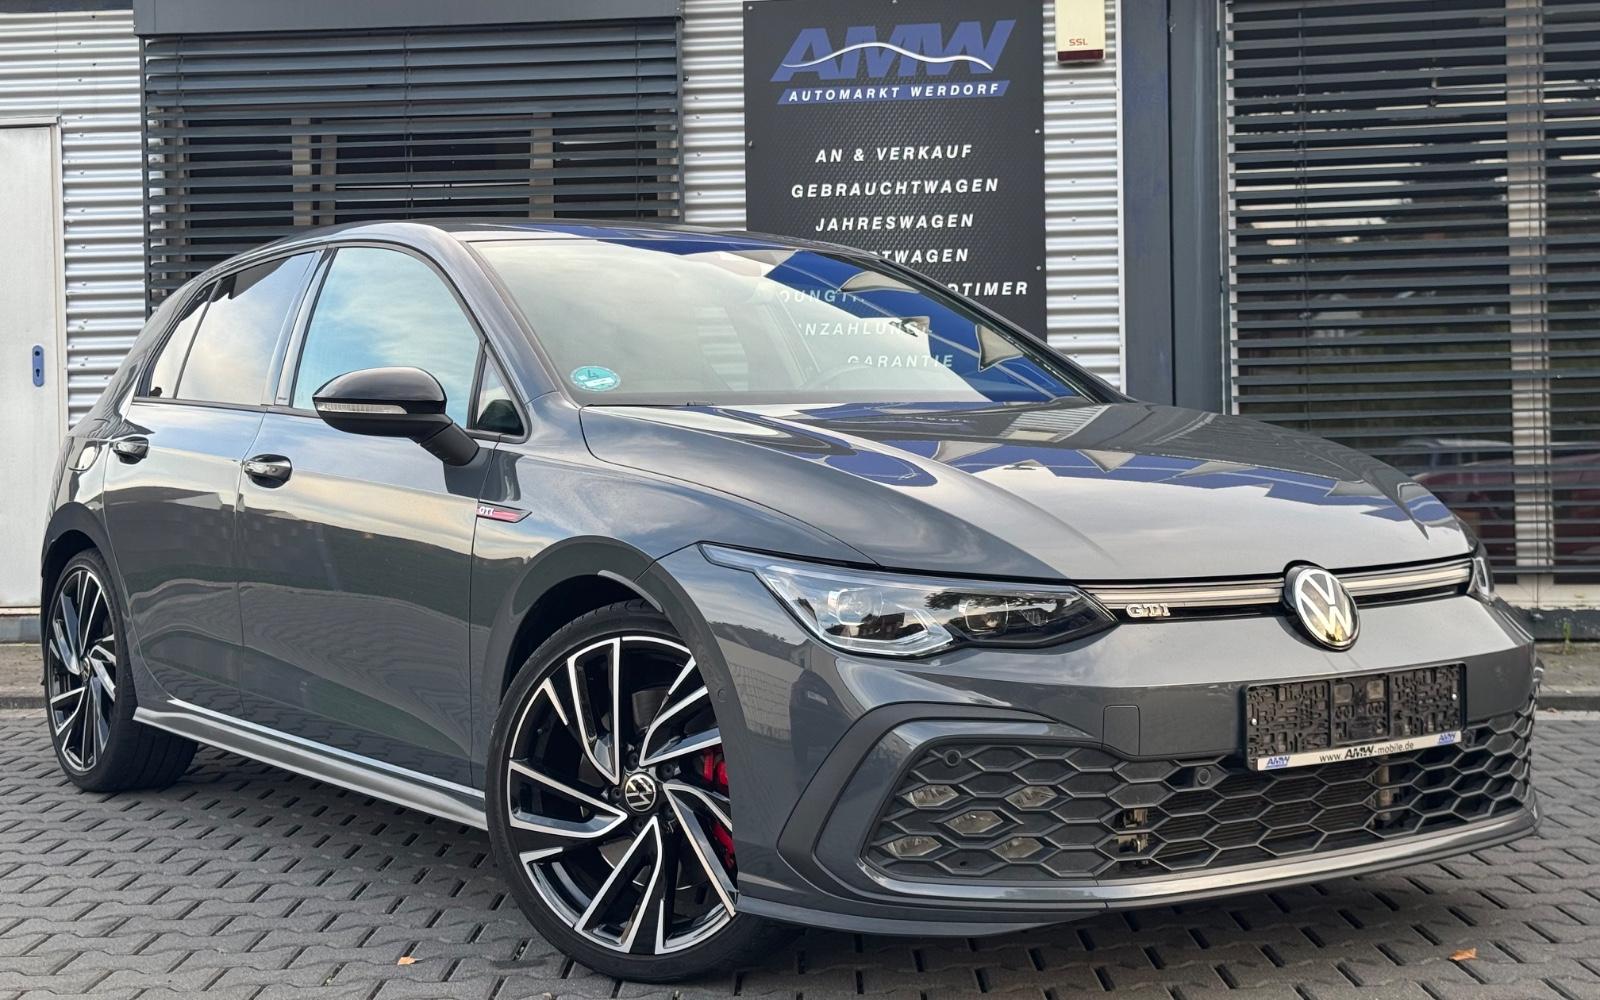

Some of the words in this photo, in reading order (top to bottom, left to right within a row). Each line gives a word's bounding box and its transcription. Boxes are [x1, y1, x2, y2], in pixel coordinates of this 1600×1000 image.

[770, 19, 1016, 82] AMW
[1068, 38, 1089, 47] SSL
[789, 87, 900, 102] AUTOMARKT
[910, 83, 1000, 97] WERDORF
[815, 149, 843, 163] AN
[853, 148, 865, 162] &
[876, 144, 973, 161] VERKAUF
[791, 178, 1000, 198] GEBRAUCHTWAGEN
[815, 213, 974, 232] JAHRESWAGEN
[869, 248, 968, 263] TWAGEN
[947, 281, 1028, 296] DTIMER
[478, 505, 494, 516] GTI
[1126, 602, 1170, 618] GTI
